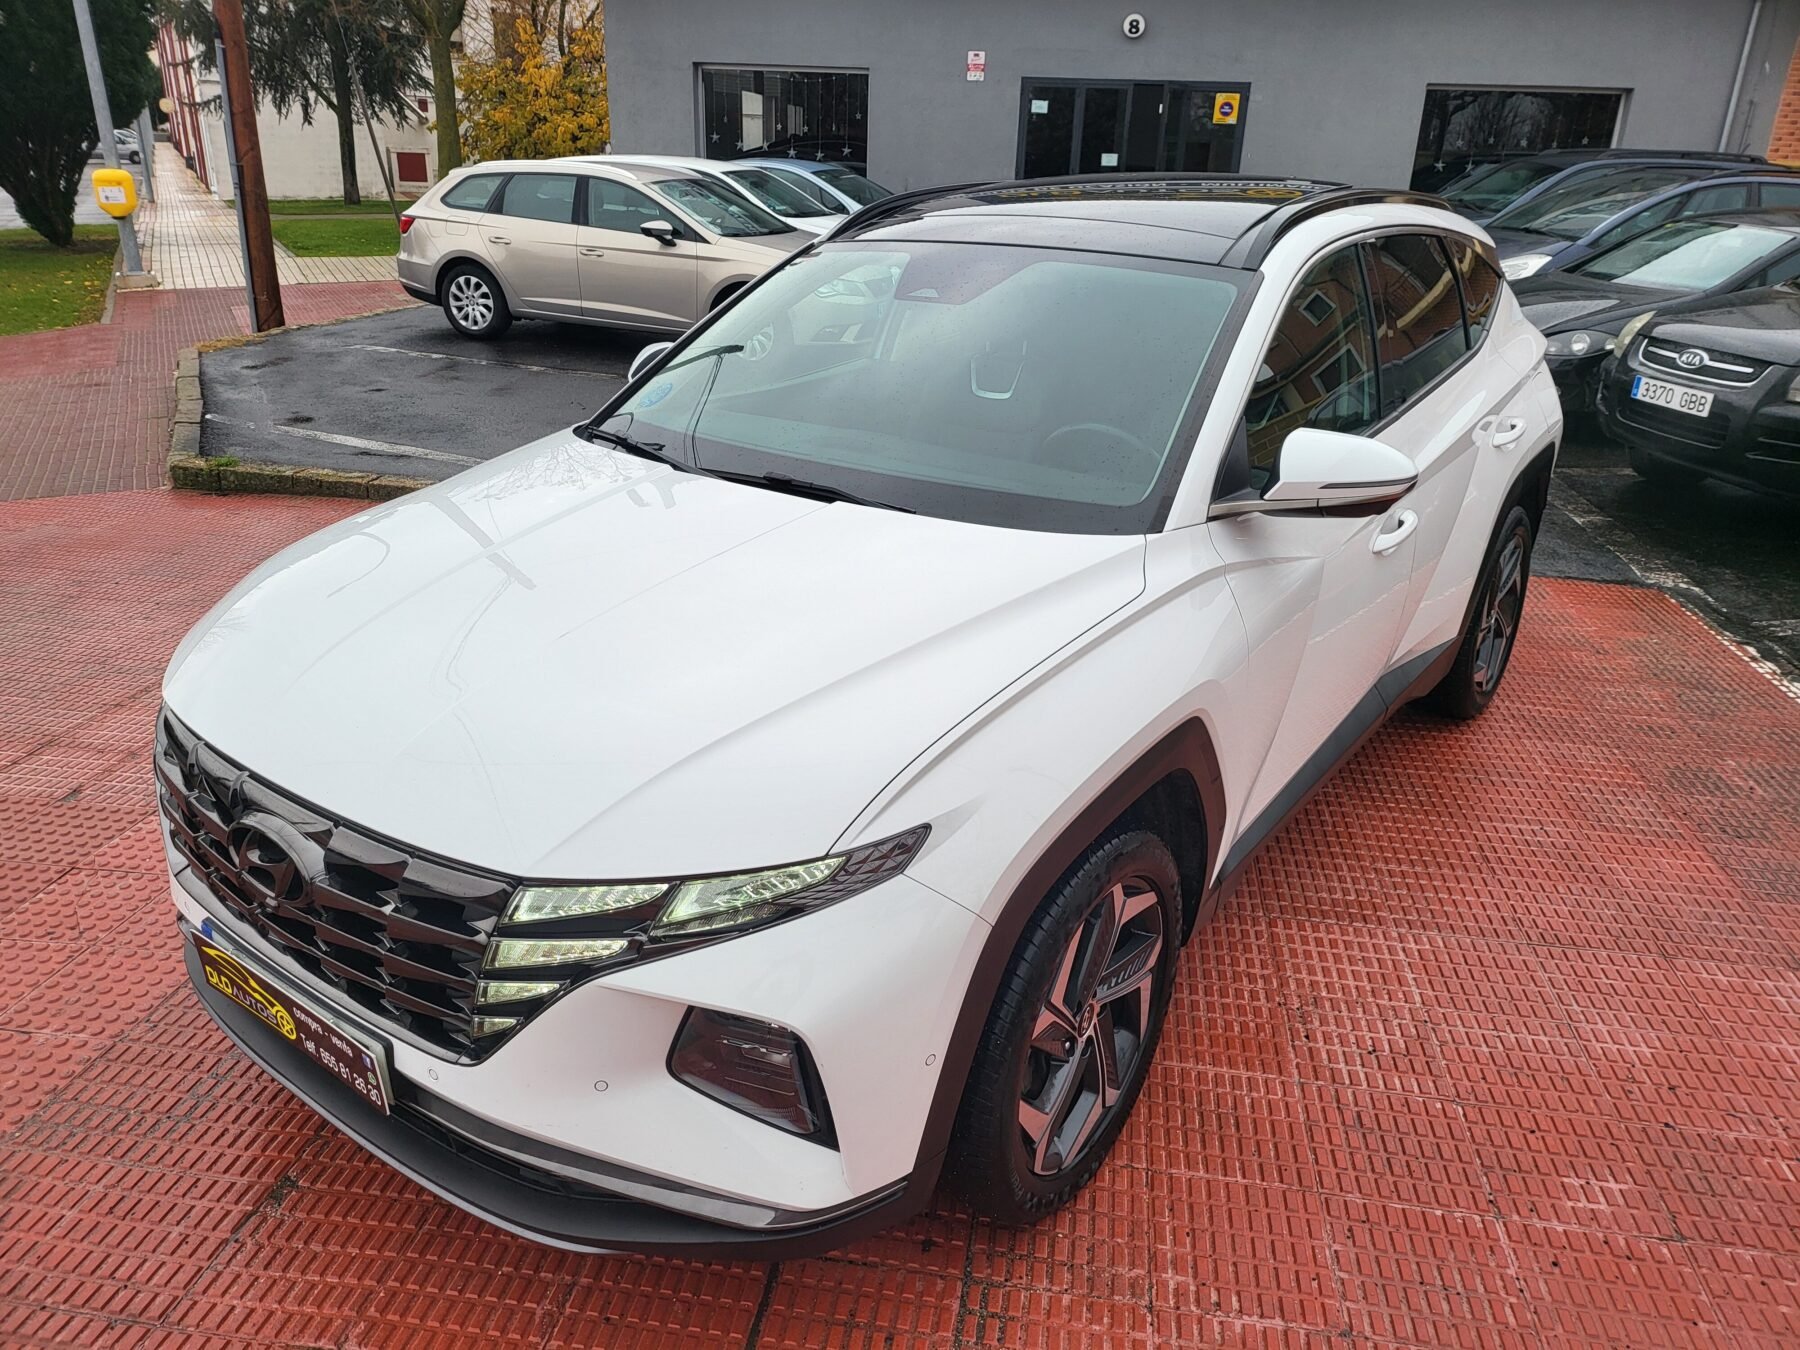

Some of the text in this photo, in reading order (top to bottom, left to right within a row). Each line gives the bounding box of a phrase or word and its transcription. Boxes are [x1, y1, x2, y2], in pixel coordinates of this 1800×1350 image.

[1128, 19, 1140, 35] 8
[1681, 353, 1701, 366] KIA
[1641, 381, 1708, 413] 3370 GBB
[204, 965, 277, 1024] DLD AUTOS
[293, 1007, 323, 1035] compra
[330, 1033, 353, 1058] venta
[300, 1032, 319, 1057] Telf.
[319, 1047, 339, 1072] 655
[339, 1062, 352, 1082] 81
[368, 1084, 382, 1106] 30
